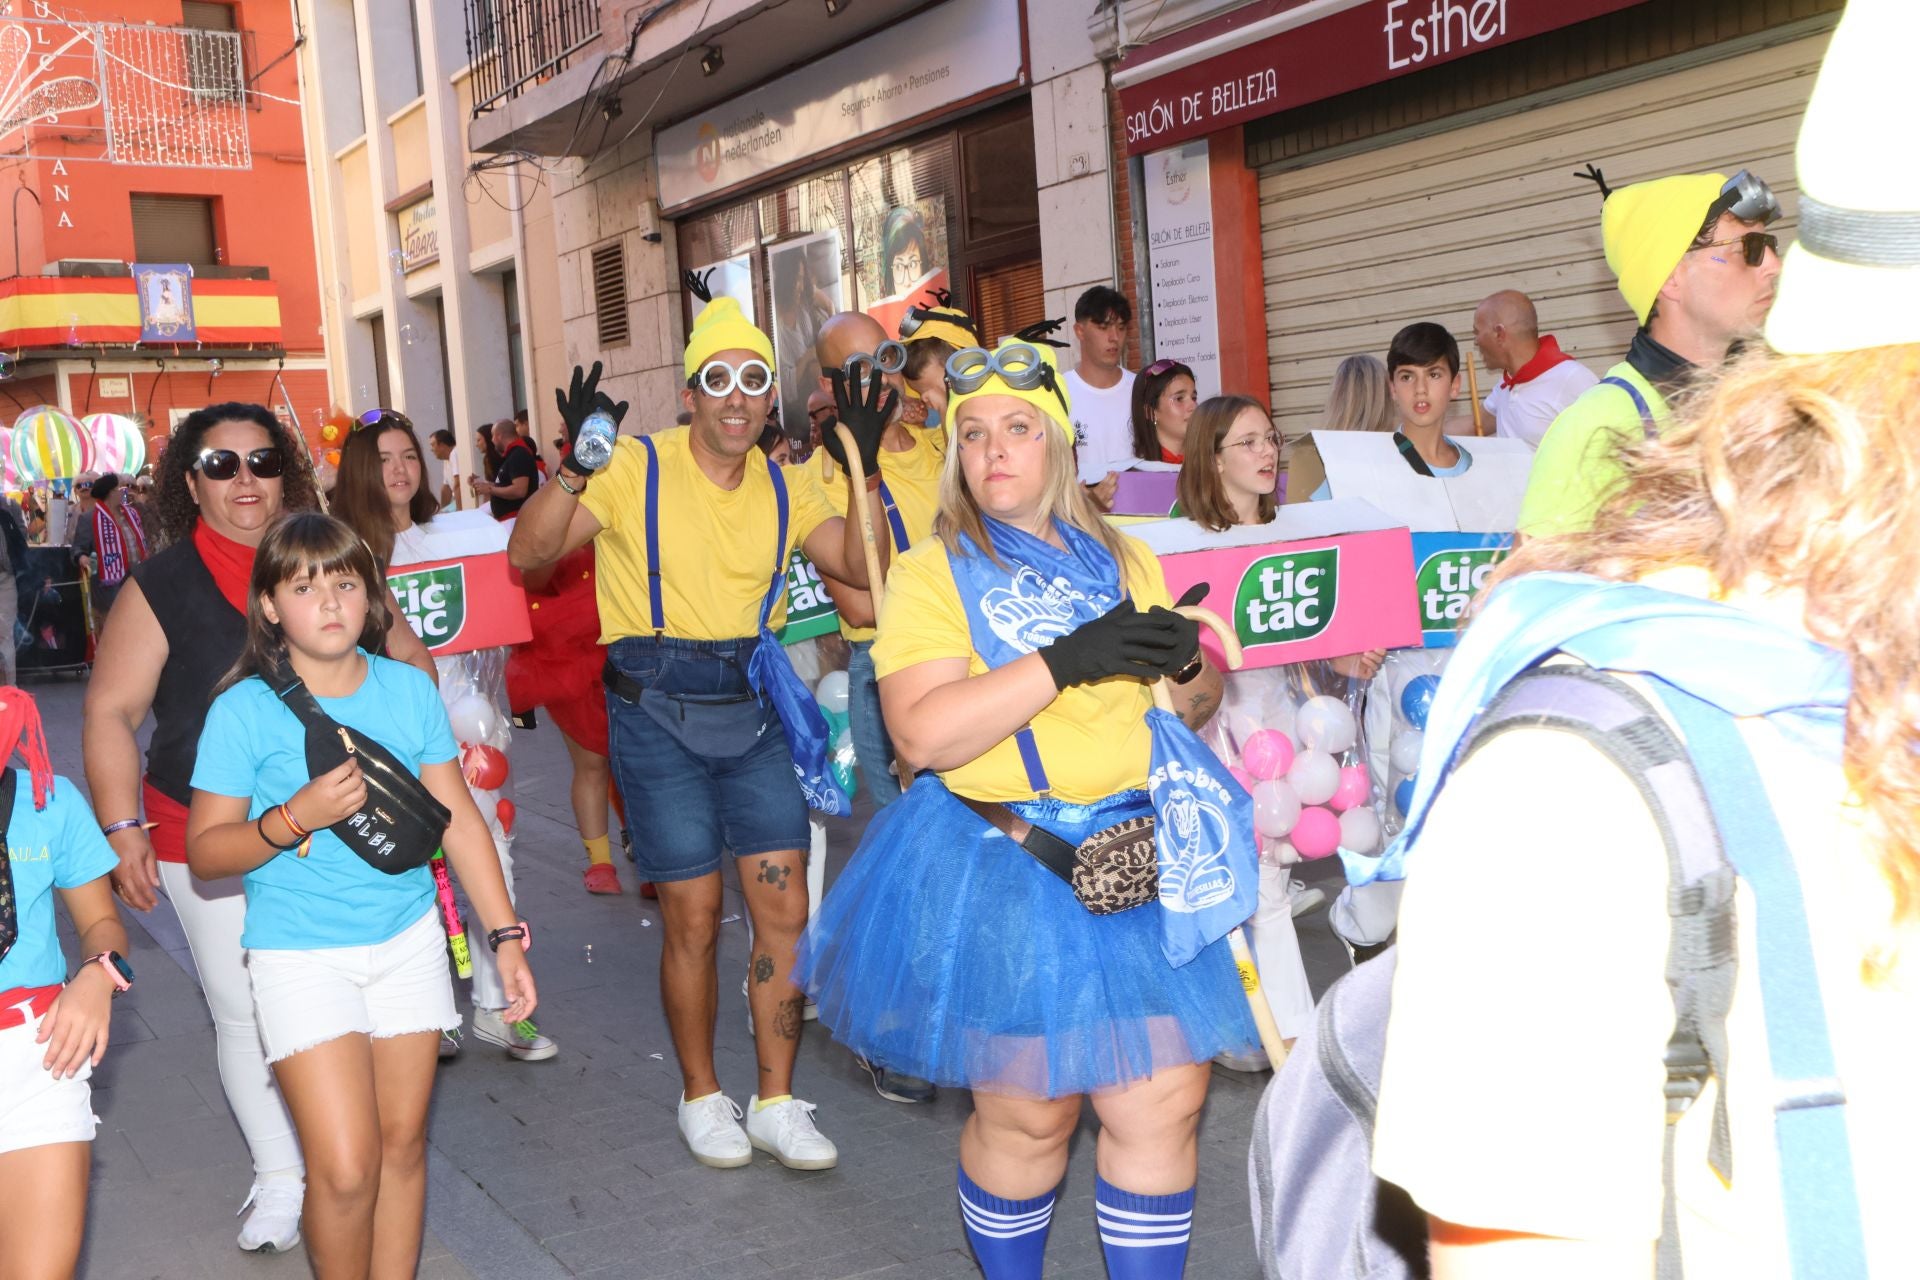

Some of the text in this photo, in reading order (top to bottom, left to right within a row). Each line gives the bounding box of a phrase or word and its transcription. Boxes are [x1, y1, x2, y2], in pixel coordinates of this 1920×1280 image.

[1383, 0, 1507, 70] Esther
[841, 65, 950, 117] Seguros Ahorro Pensiones
[1127, 68, 1277, 143] SALÓN DE BELLEZA
[723, 109, 766, 140] nationale
[725, 128, 782, 162] nederlanden
[1166, 170, 1188, 186] Esther
[1151, 221, 1211, 245] SALÓN DE BELLEZA
[787, 581, 834, 615] ac
[1259, 560, 1320, 602] tic
[1246, 597, 1320, 633] tac
[1423, 589, 1471, 620] ta
[405, 609, 449, 638] ac
[347, 812, 396, 856] ALBA
